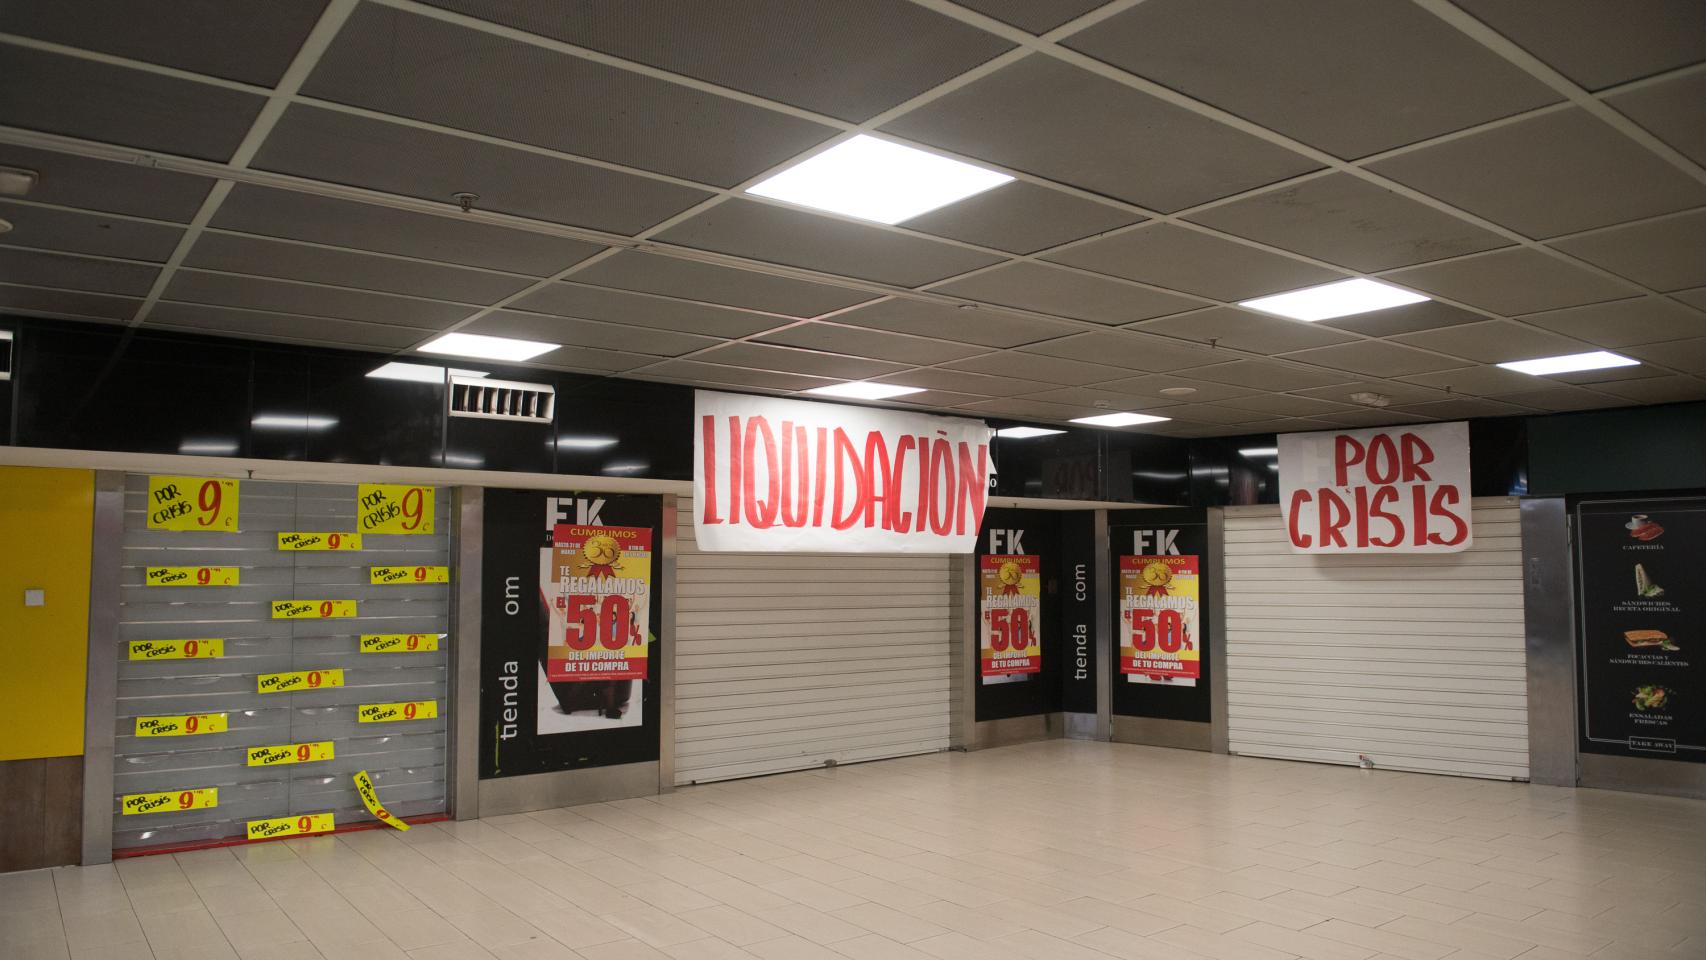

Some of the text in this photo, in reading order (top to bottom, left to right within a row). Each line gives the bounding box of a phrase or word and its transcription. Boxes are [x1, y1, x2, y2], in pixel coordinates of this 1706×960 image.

[1335, 432, 1435, 487] POR
[703, 414, 987, 538] LIQUIDACIÓN
[154, 484, 182, 504] POR
[361, 489, 387, 510] POR
[197, 480, 222, 526] 9
[401, 488, 423, 530] 9
[153, 500, 192, 525] CRISIS
[363, 502, 401, 530] CRISIS
[546, 497, 606, 531] FK
[1288, 484, 1469, 549] CRISIS
[281, 534, 302, 545] POR
[328, 533, 341, 549] 9
[570, 528, 638, 539] CUMPLIMOS
[989, 528, 1025, 555] FK
[294, 535, 321, 549] CRISIS
[1133, 529, 1181, 556] FK
[149, 568, 170, 579] POR
[197, 567, 211, 585] 9
[373, 568, 391, 578] POR
[383, 570, 408, 582] CRISIS
[415, 566, 427, 581] 9
[559, 565, 570, 577] TE
[560, 576, 646, 595] REGALAMOS
[275, 602, 293, 612] POR
[320, 600, 333, 617] 9
[1126, 594, 1194, 609] REGALAMOS
[286, 604, 313, 617] CRISIS
[556, 594, 642, 651] EL 50%
[991, 608, 1036, 652] 50%
[1073, 564, 1087, 680] tienda com
[1132, 608, 1193, 653] 50%
[132, 642, 154, 654] POR
[184, 640, 198, 658] 9
[363, 636, 381, 648] POR
[375, 637, 401, 651] CRISIS
[406, 634, 419, 650] 9
[146, 645, 176, 658] CRISIS
[569, 650, 625, 660] DEL IMPORTE
[565, 661, 629, 672] DE TU COMPRA
[1133, 660, 1183, 670] DE TU COMPRA
[261, 676, 280, 689] POR
[276, 676, 302, 690] CRISIS
[307, 671, 321, 688] 9
[498, 661, 519, 740] tienda
[362, 706, 380, 717] POR
[373, 707, 398, 721] CRISIS
[404, 703, 416, 720] 9
[139, 719, 160, 730] POR
[151, 722, 178, 735] CRISIS
[185, 716, 199, 734] 9
[251, 748, 271, 761] POR
[263, 750, 292, 764] CRISIS
[297, 744, 310, 762] 9
[126, 795, 147, 808] POR
[138, 796, 171, 813] CRISIS
[179, 791, 194, 810] 9
[250, 821, 271, 834] POR
[263, 823, 291, 837] CRISIS
[297, 815, 312, 833] 9
